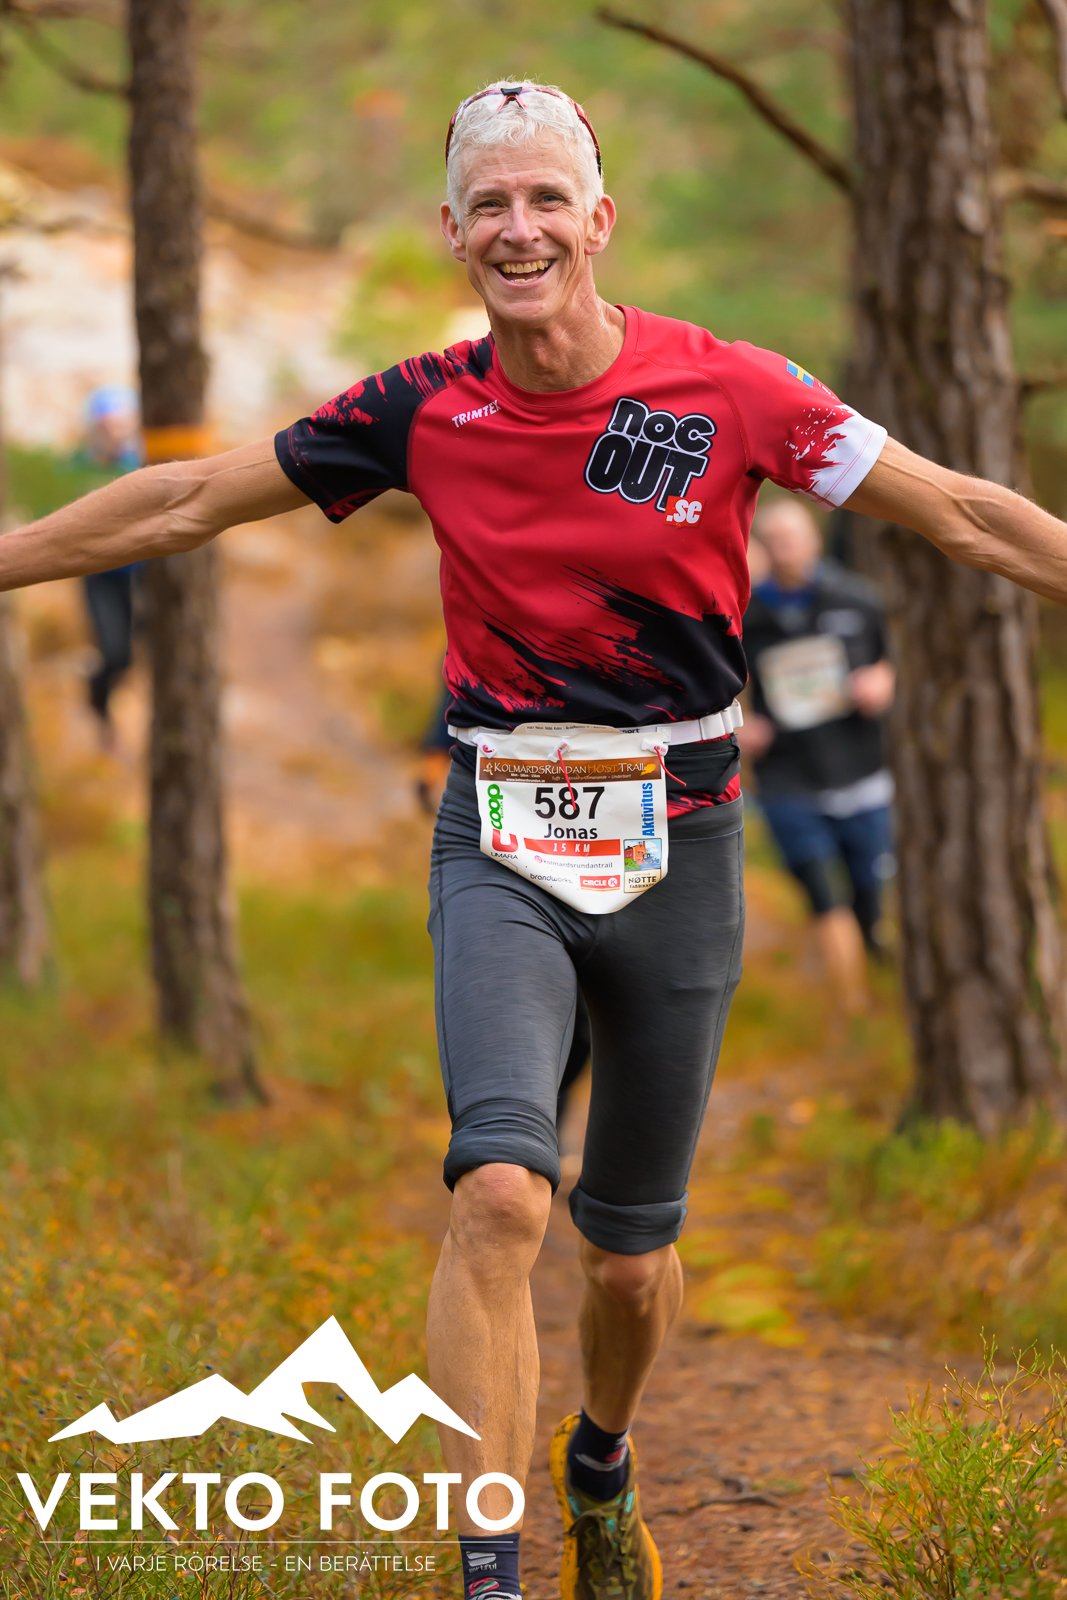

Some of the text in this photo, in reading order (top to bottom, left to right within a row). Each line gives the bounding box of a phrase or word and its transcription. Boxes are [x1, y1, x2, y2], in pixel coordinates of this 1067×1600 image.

[451, 399, 502, 428] TRIMTEX
[585, 431, 709, 511] OUT
[487, 783, 503, 830] coop
[535, 786, 605, 820] 587
[641, 782, 655, 837] Aktivitus
[544, 823, 598, 839] Jonas
[553, 842, 591, 853] 15 KM
[582, 879, 607, 887] CIRCLE
